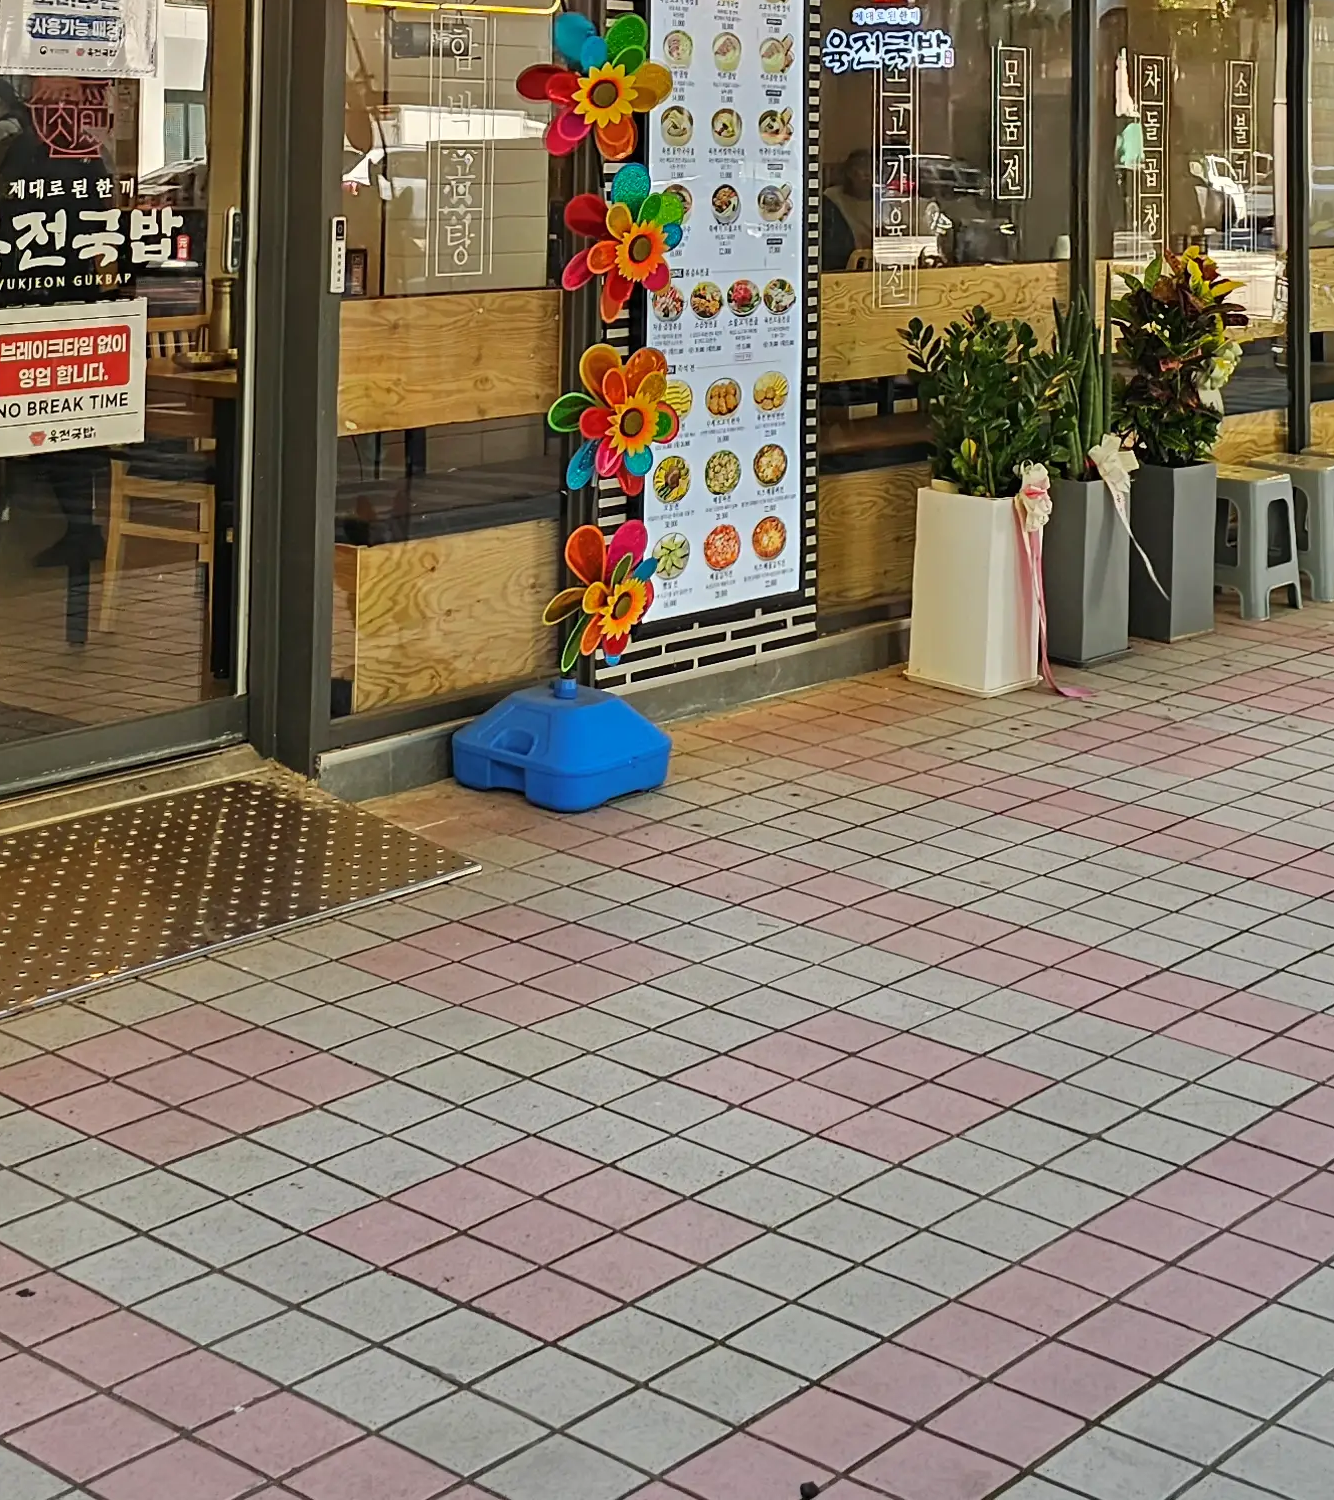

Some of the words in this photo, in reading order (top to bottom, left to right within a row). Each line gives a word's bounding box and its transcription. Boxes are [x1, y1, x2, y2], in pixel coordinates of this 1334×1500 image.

[33, 18, 90, 36] 사용가능
[823, 30, 951, 73] 육전국밥
[1143, 64, 1161, 260] 차돌곱창
[72, 272, 132, 287] GUKBAP
[0, 336, 94, 361] 브레이크타임
[97, 333, 127, 354] 없이
[19, 366, 51, 388] 영업
[56, 362, 109, 386] 합니다.
[27, 396, 84, 416] BREAK
[89, 392, 129, 410] TIME
[48, 426, 94, 443] 육전국밥
